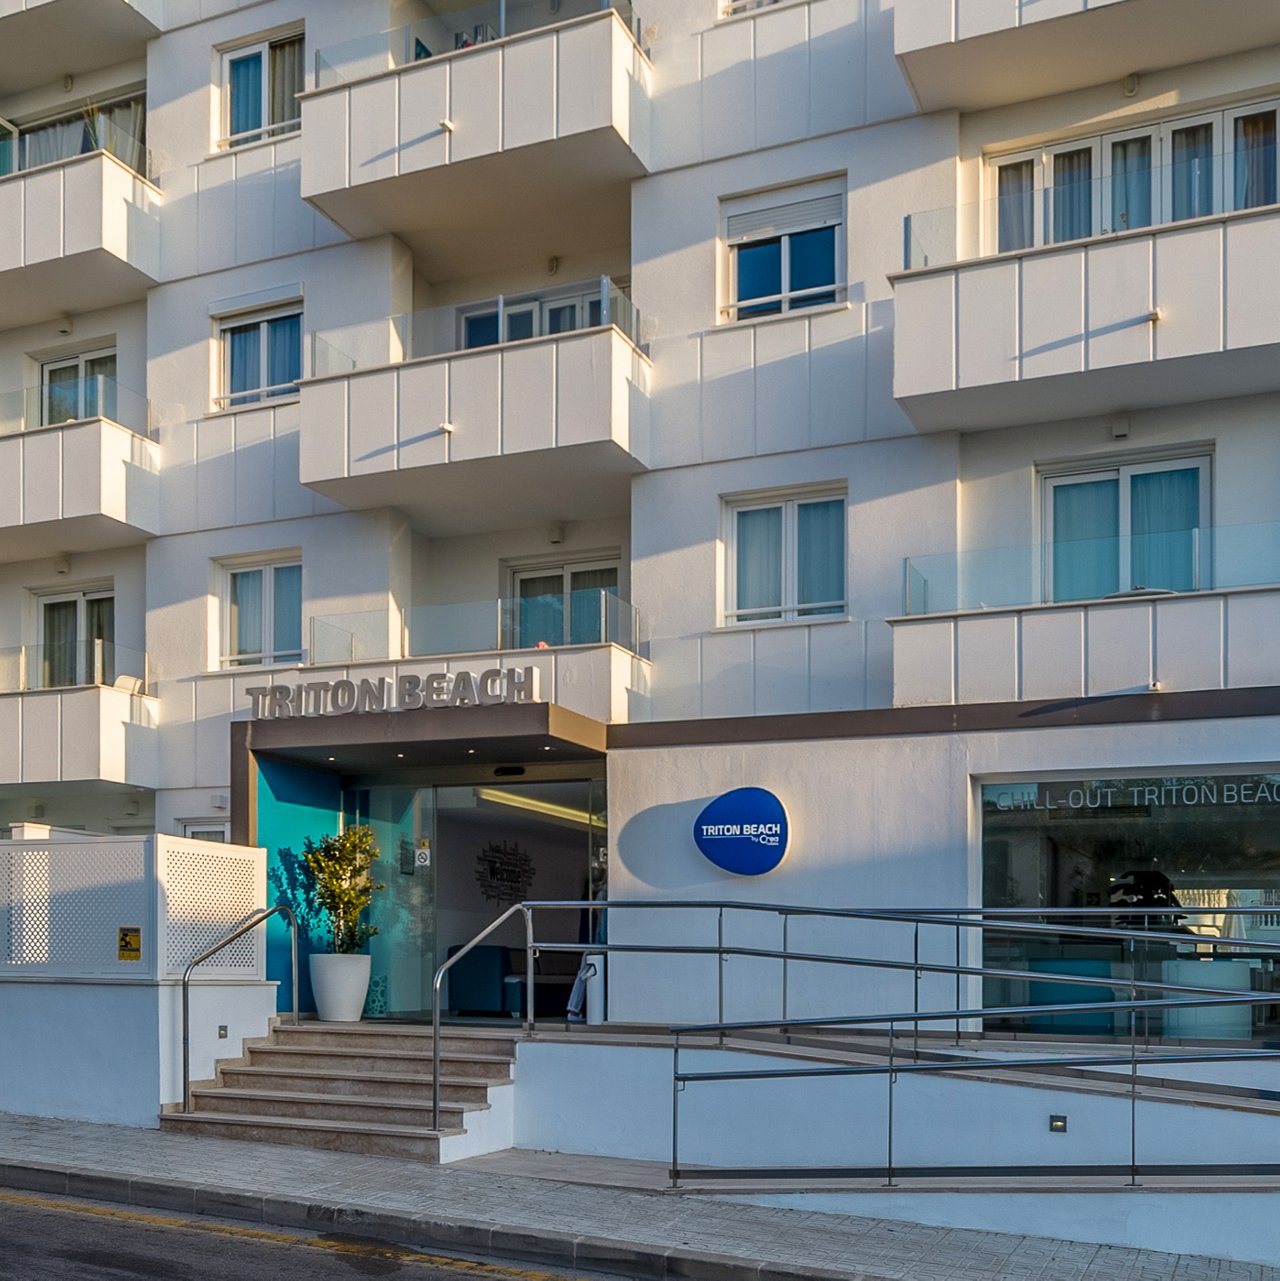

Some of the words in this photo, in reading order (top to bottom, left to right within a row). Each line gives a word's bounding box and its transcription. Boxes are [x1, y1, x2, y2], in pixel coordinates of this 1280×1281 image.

[246, 676, 387, 719] TRITON
[398, 666, 535, 710] BEACH
[996, 787, 1117, 811] CHILL-OUT
[1131, 784, 1218, 806] TRITON
[701, 825, 740, 835] TRITON
[743, 824, 780, 834] BEACH
